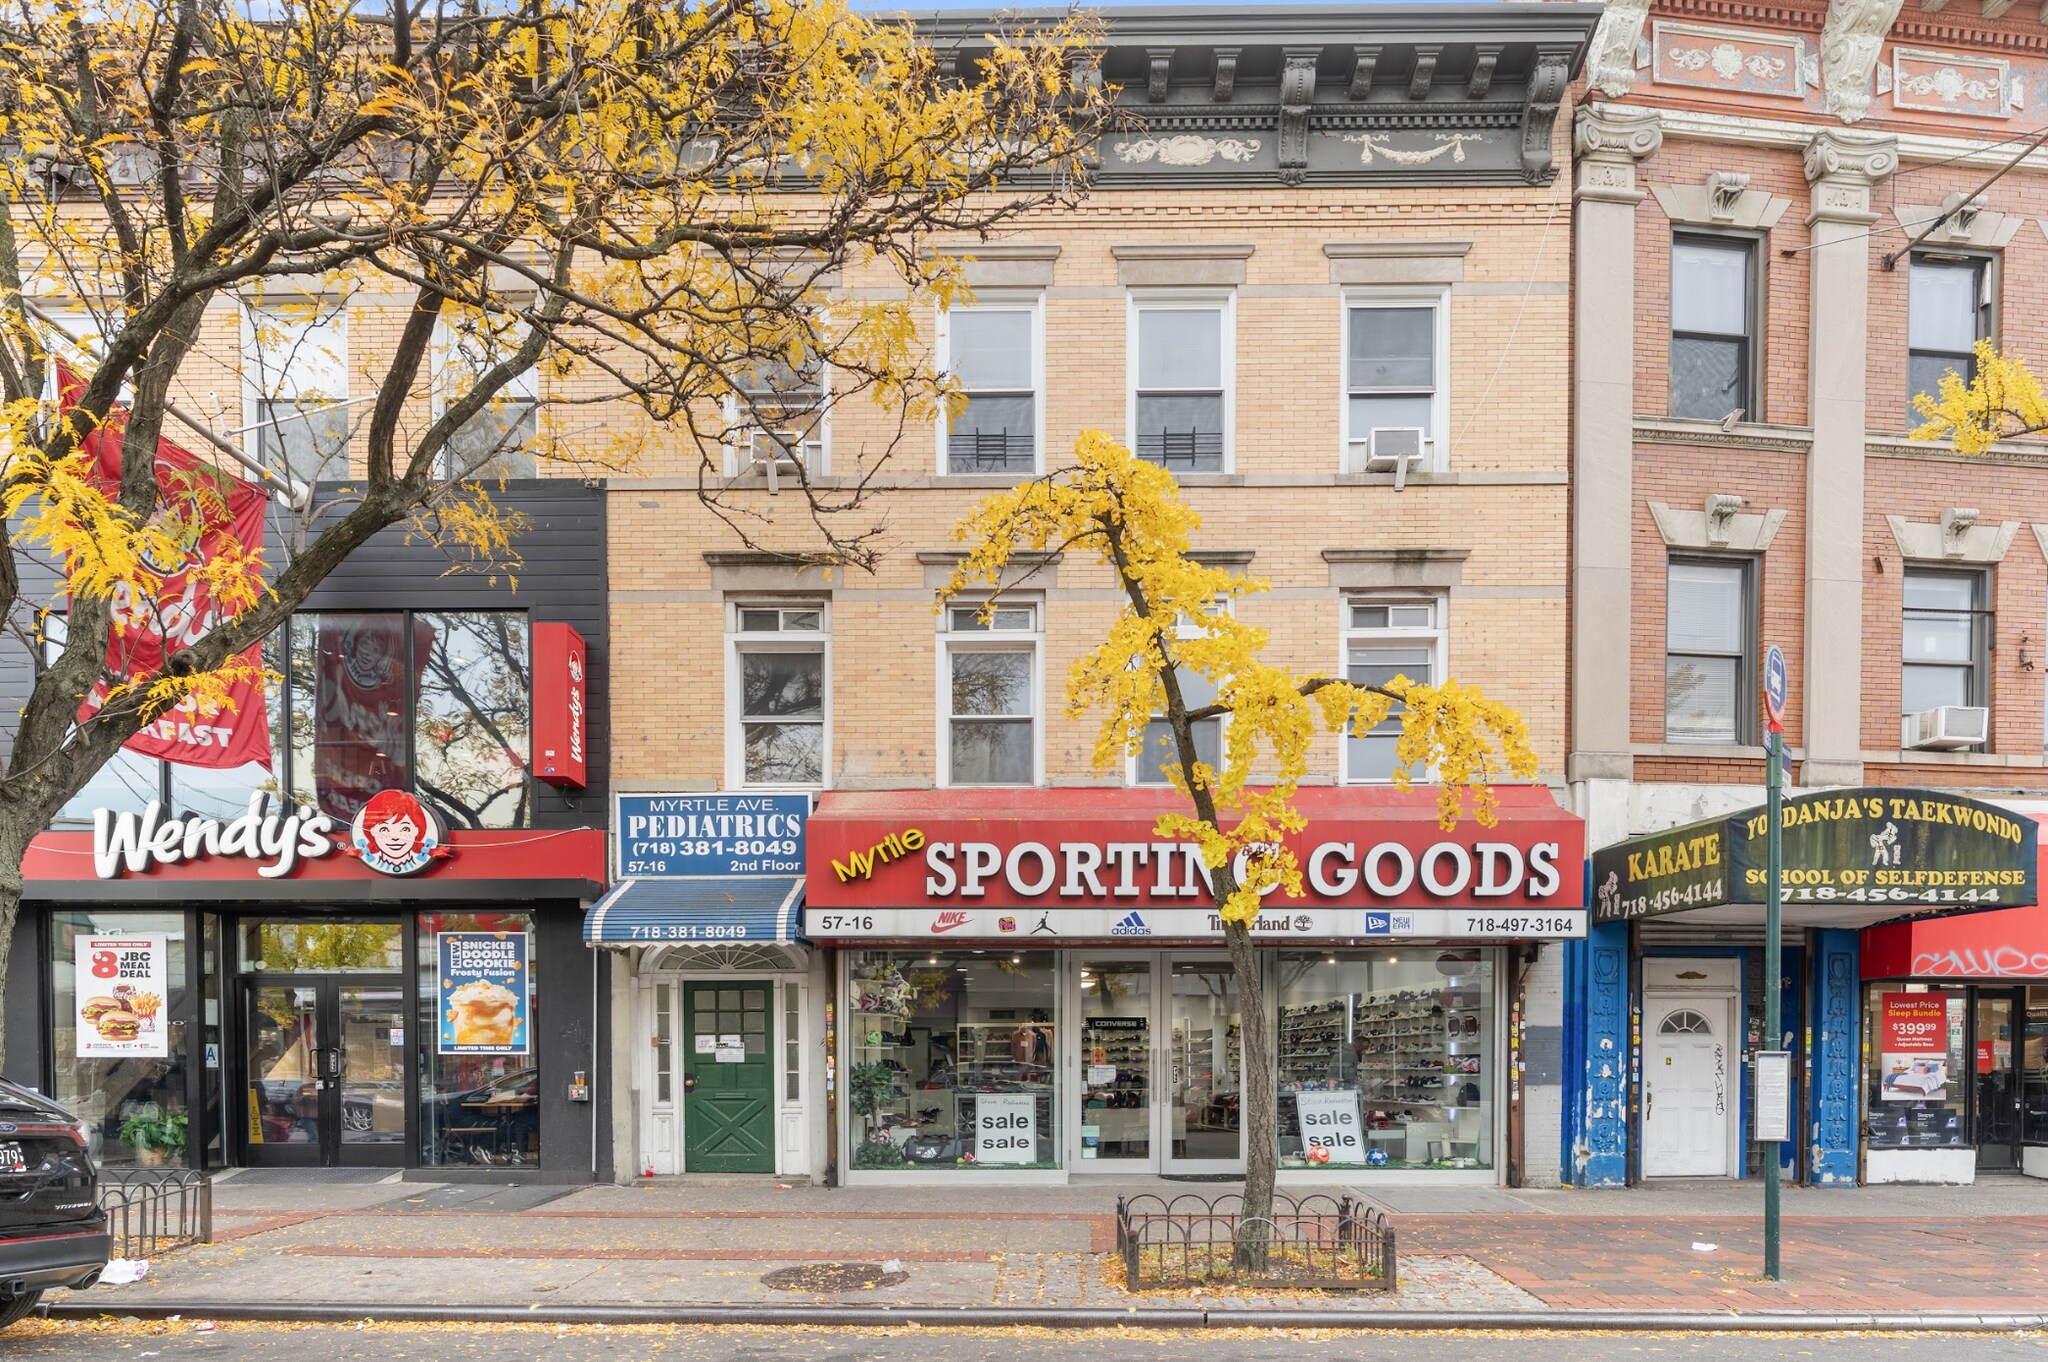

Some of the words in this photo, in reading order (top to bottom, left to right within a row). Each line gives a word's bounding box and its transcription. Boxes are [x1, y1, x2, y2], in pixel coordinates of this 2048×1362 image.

[568, 687, 583, 763] Wendy's
[650, 800, 729, 812] MYRTLE
[736, 799, 779, 811] AVE.
[628, 814, 801, 838] PEDIATRICS
[1747, 798, 1883, 840] YODANJA'S
[1890, 799, 2022, 844] TAEKWONDO
[91, 788, 336, 879] Wendy's
[633, 842, 676, 857] (718)
[679, 840, 797, 856] 381-8049
[831, 828, 926, 883] Myrtle
[1628, 833, 1721, 882] KARATE
[628, 861, 666, 872] 57-16
[730, 860, 758, 872] 2nd
[762, 860, 801, 871] Floor
[1308, 842, 1561, 897] GOODS
[1840, 870, 1869, 885] OF
[1875, 869, 2026, 885] SELFDEFENSE
[1622, 879, 1723, 919] 718-456-4144
[1780, 887, 2000, 902] 718-456-4144
[822, 916, 873, 930] 57-16
[938, 912, 967, 924] NIKE
[1467, 918, 1573, 932] 718-497-3164
[630, 926, 746, 939] 718-381-8049
[1111, 925, 1152, 936] adidas
[462, 942, 515, 950] SNICKER
[120, 952, 151, 961] JBC
[452, 944, 460, 966] NEW
[462, 950, 515, 959] DOODLE
[462, 959, 515, 968] COOKIE
[120, 970, 151, 978] DEAL
[450, 969, 481, 978] Frosty
[1888, 1010, 1911, 1018] Sleep
[1913, 1009, 1942, 1017] Bundle
[206, 1047, 216, 1060] A
[982, 1112, 1029, 1129] sale
[1305, 1110, 1353, 1126] sale
[982, 1136, 1030, 1149] sale
[1308, 1132, 1356, 1147] sale
